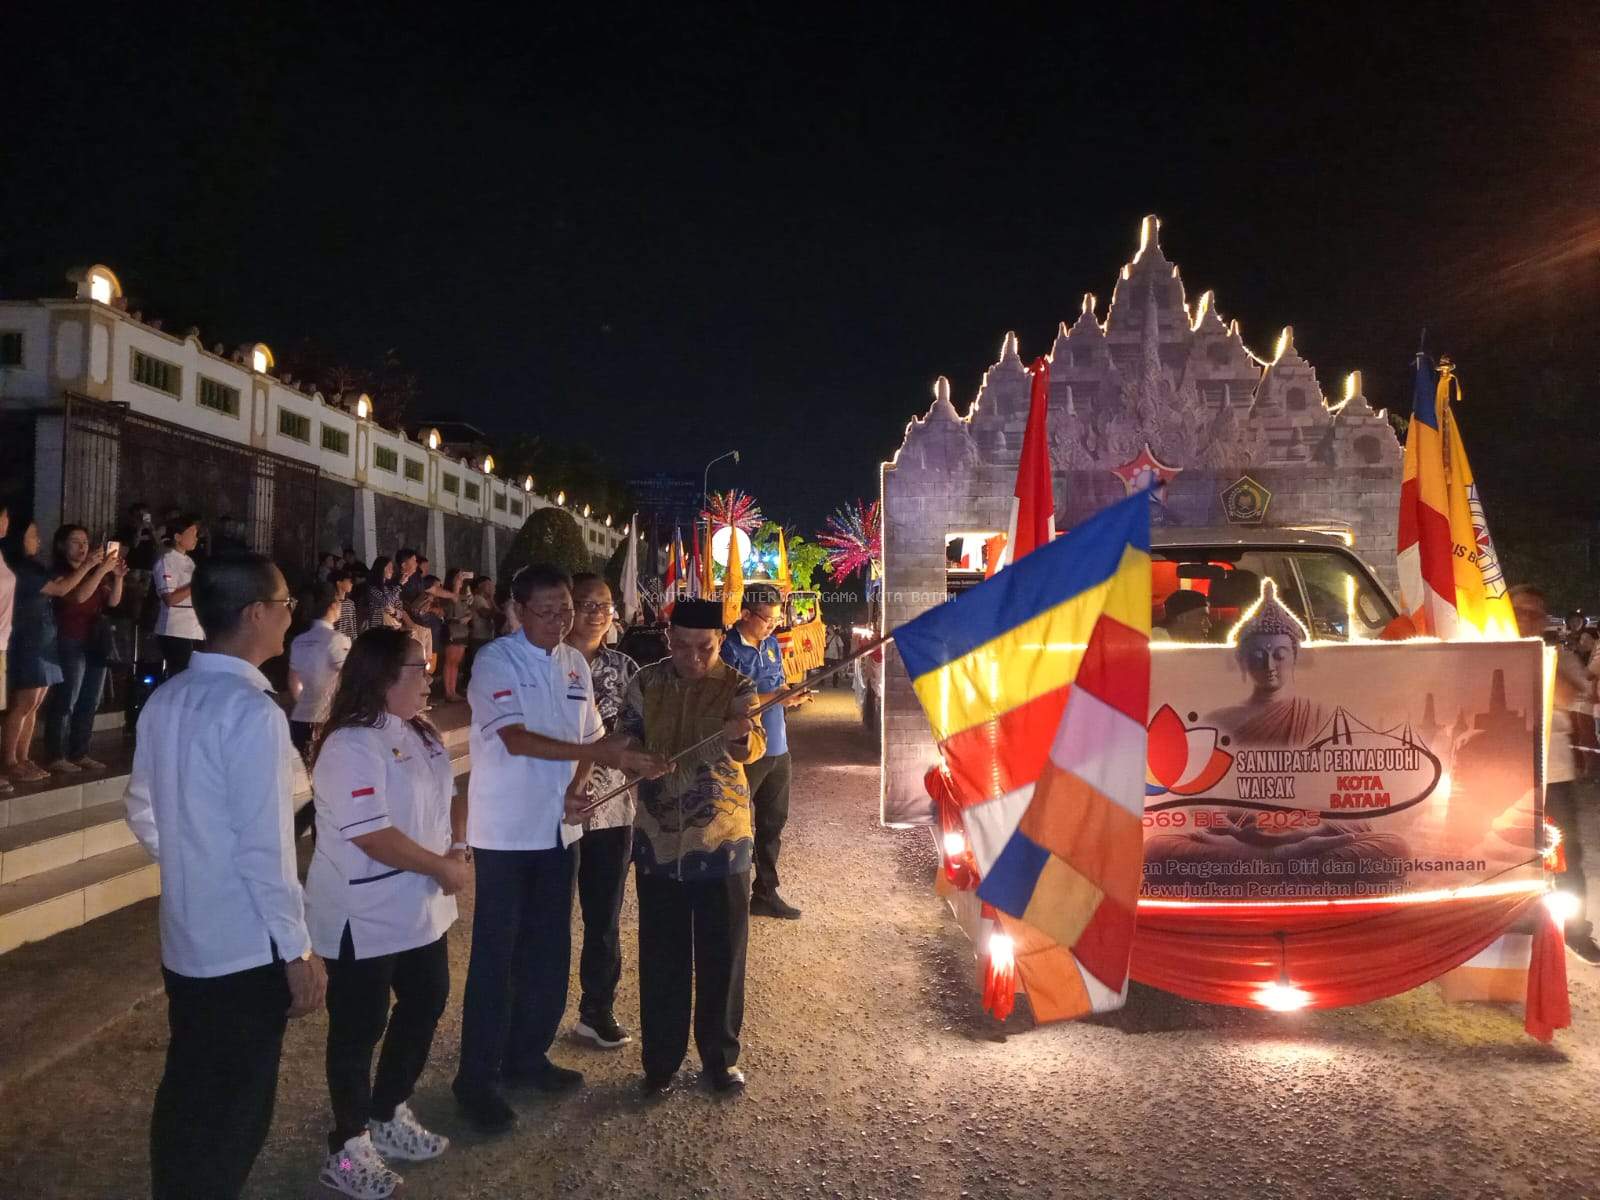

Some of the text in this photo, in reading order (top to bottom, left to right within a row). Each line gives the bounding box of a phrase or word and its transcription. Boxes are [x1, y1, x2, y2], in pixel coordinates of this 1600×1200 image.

[1237, 748, 1421, 773] SANNIPATA PERMABUDHI
[1237, 775, 1296, 799] WAISAK
[1336, 775, 1384, 791] KOTA
[1329, 793, 1391, 809] BATAM
[1142, 811, 1187, 828] 569
[1194, 811, 1229, 828] BE
[1257, 810, 1322, 830] 2025
[1142, 857, 1487, 877] an Pengendalian Diri dan Kebijaksanaan
[1247, 881, 1351, 898] Perdamaian
